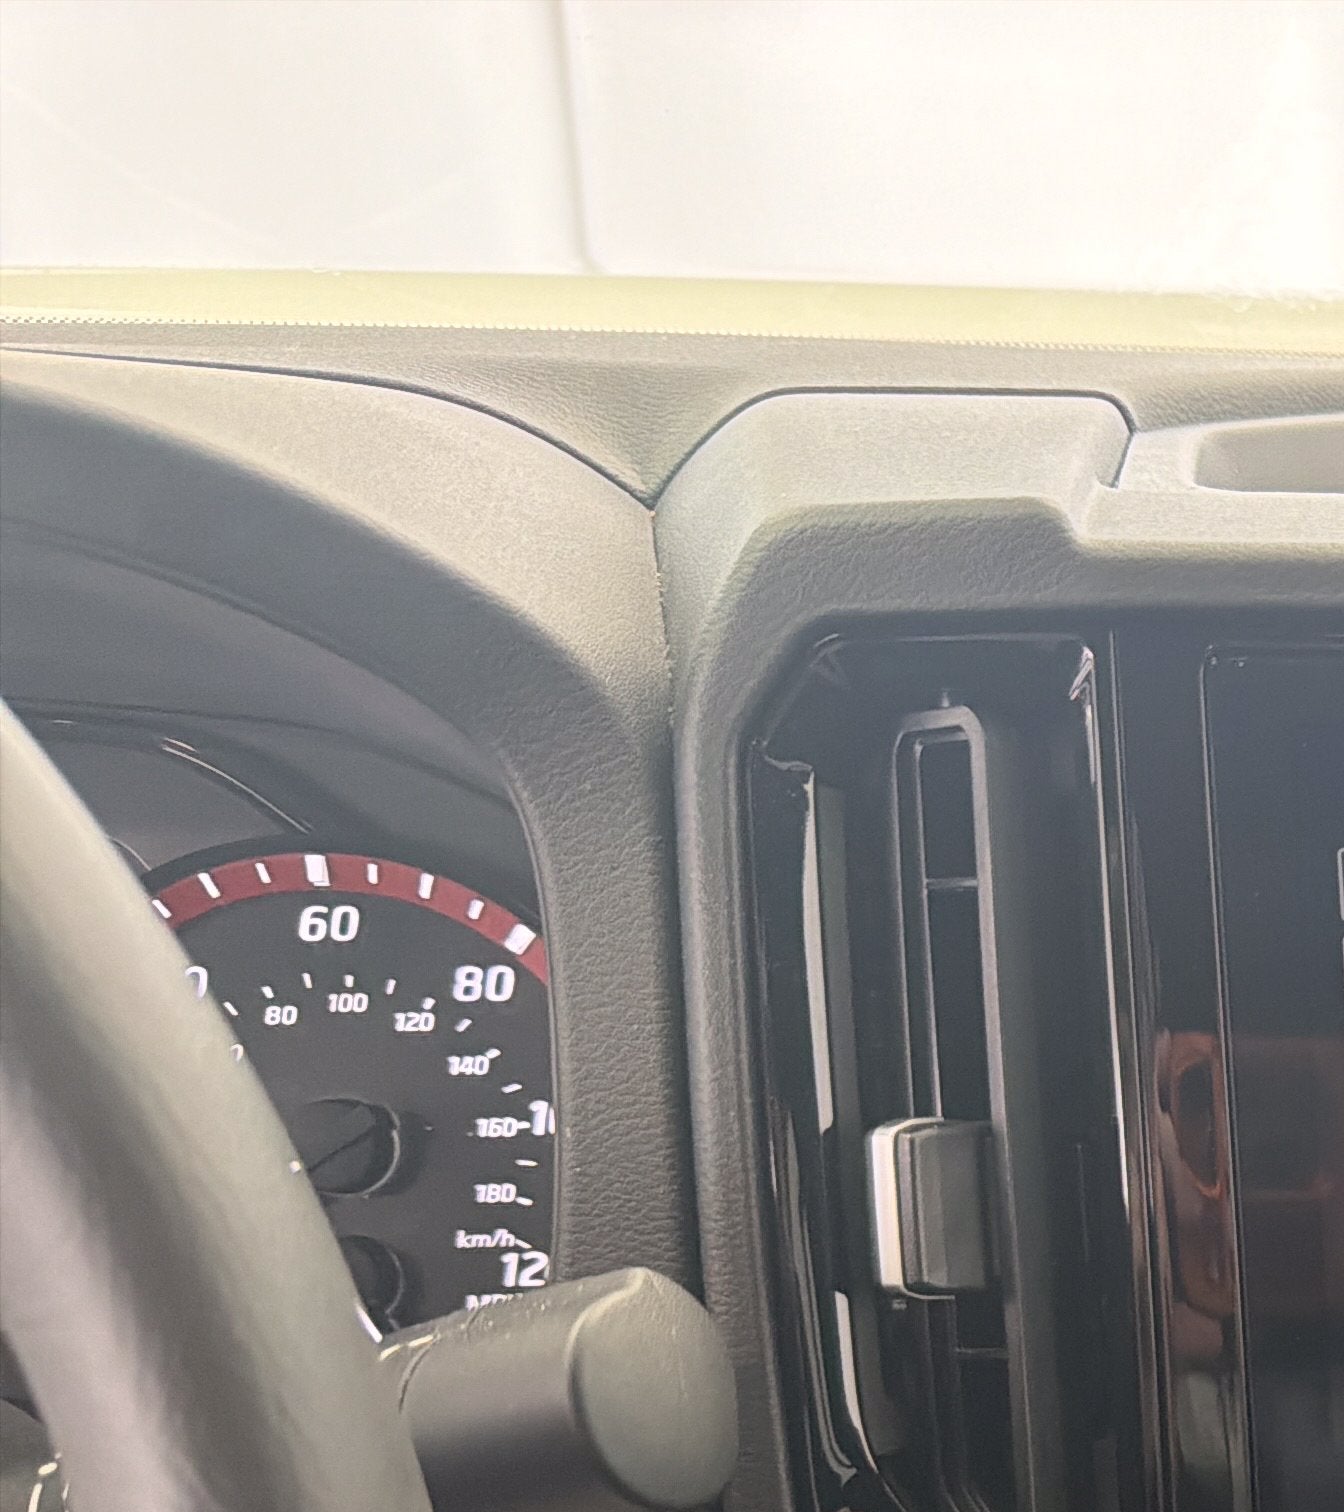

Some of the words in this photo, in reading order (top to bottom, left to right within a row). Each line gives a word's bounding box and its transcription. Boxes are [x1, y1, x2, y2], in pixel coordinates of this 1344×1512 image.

[298, 905, 359, 942] 60
[453, 965, 515, 1002] 80
[328, 993, 368, 1013] 100
[264, 1005, 299, 1027] 80
[394, 1012, 435, 1033] 120
[447, 1055, 490, 1077] 140
[474, 1117, 519, 1138] 160
[474, 1183, 517, 1204] 180
[455, 1229, 516, 1249] km/h
